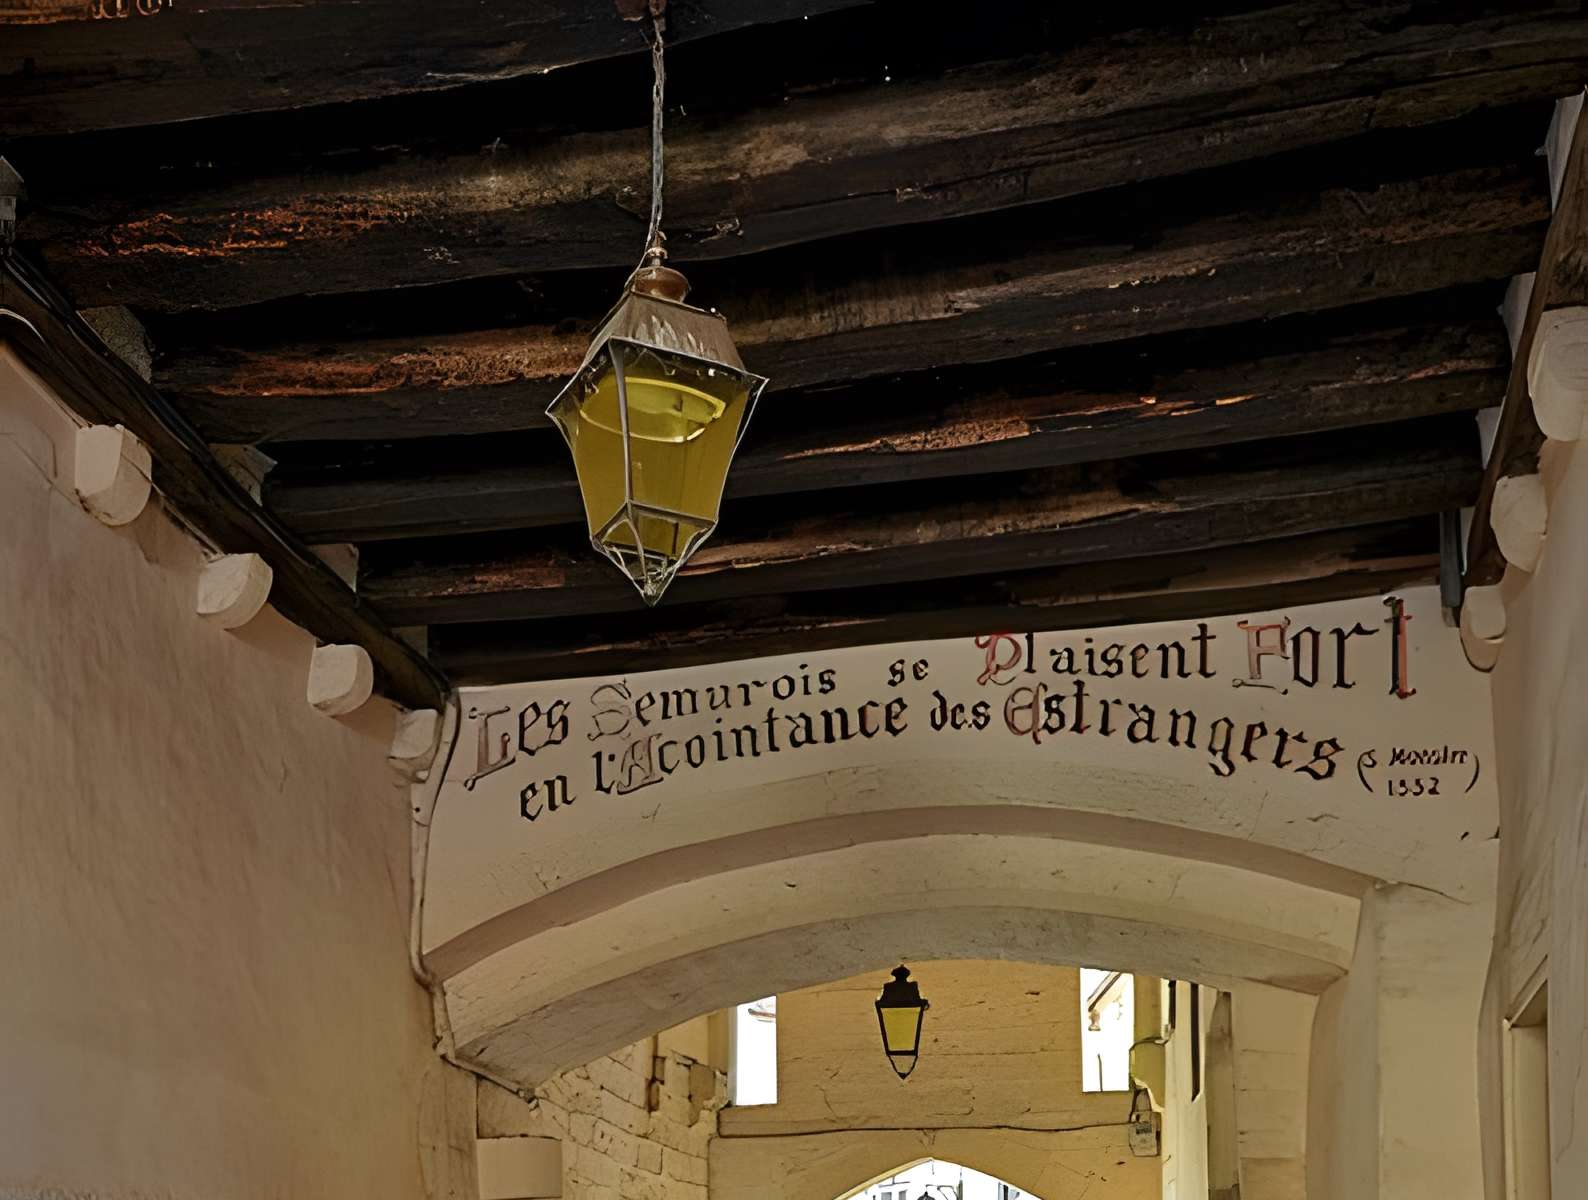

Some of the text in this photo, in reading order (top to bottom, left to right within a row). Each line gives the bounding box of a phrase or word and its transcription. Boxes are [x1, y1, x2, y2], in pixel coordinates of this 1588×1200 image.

[464, 596, 1418, 791] Les Semurois se Plaisent Fort
[519, 774, 577, 822] en
[930, 690, 991, 732] des
[1003, 680, 1344, 779] Estrangers
